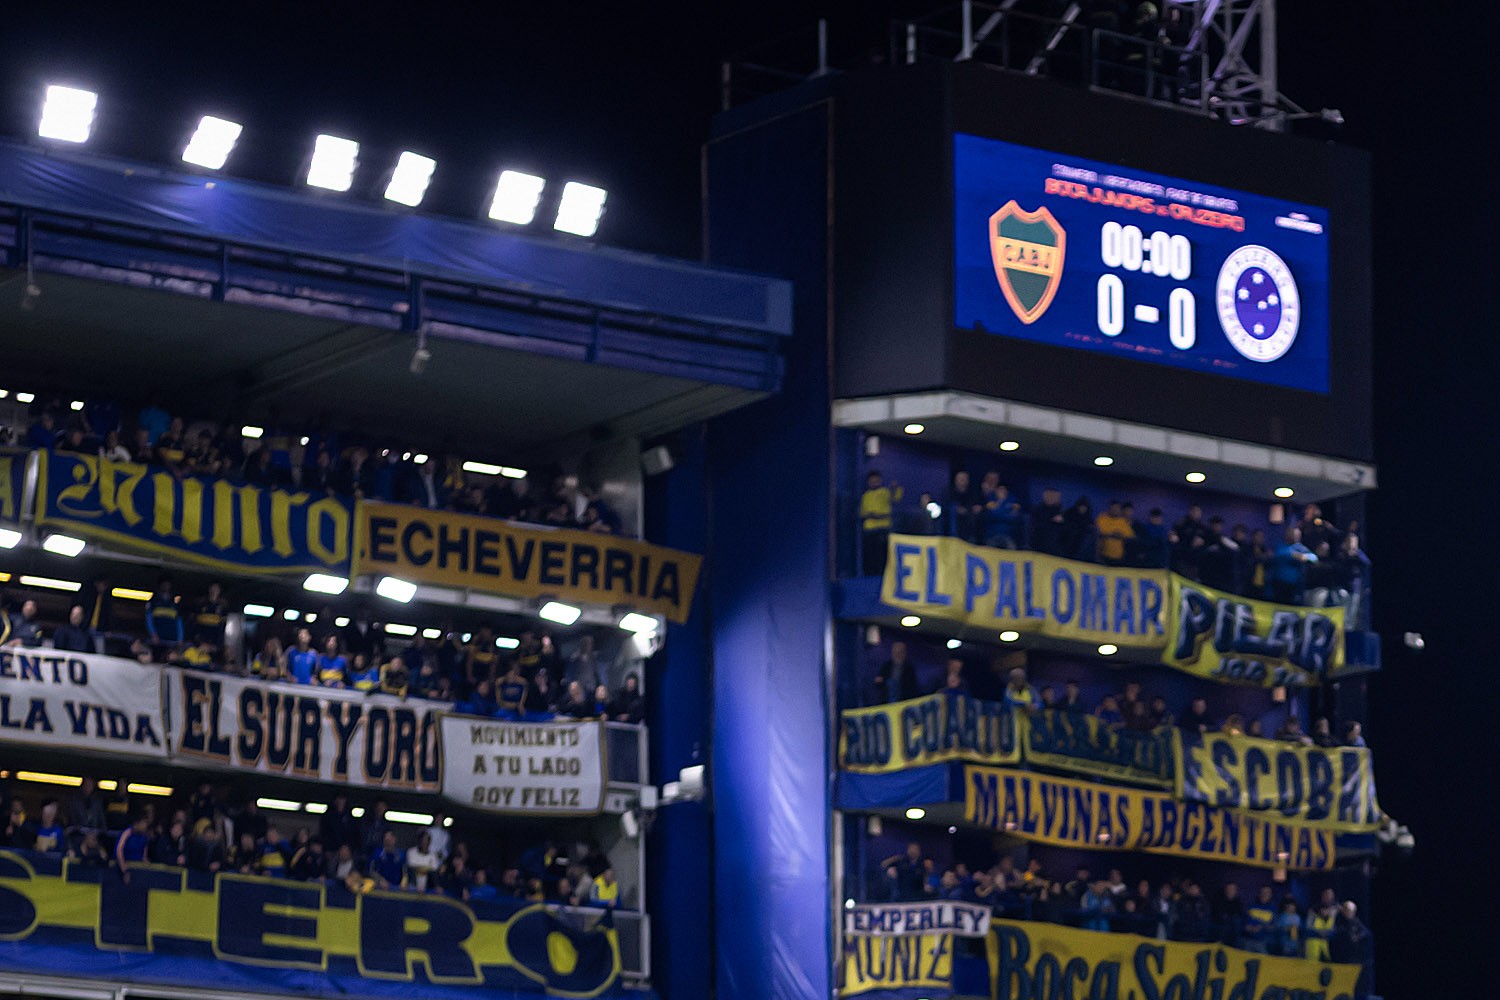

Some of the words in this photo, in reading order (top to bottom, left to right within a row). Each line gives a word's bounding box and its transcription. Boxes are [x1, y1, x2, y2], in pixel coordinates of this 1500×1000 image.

[1101, 221, 1192, 281] 00:00
[1097, 273, 1125, 337] 0
[1169, 287, 1196, 350] 0
[369, 519, 682, 606] ECHEVERRIA
[893, 543, 951, 606] EL
[963, 553, 1166, 636] PALOMAR
[1174, 586, 1336, 672] PILAR
[65, 701, 161, 747] VIDA
[180, 675, 231, 756] EL
[470, 725, 580, 747] MOVIMIENTO
[473, 755, 488, 775] A
[492, 755, 521, 775] TU
[528, 756, 582, 776] LADO
[473, 785, 513, 807] SOY
[520, 787, 581, 807] FELIZ
[1181, 739, 1378, 825] ESCOBA
[971, 769, 1131, 847] MALVINAS
[1132, 794, 1331, 871] ARGENTINAS
